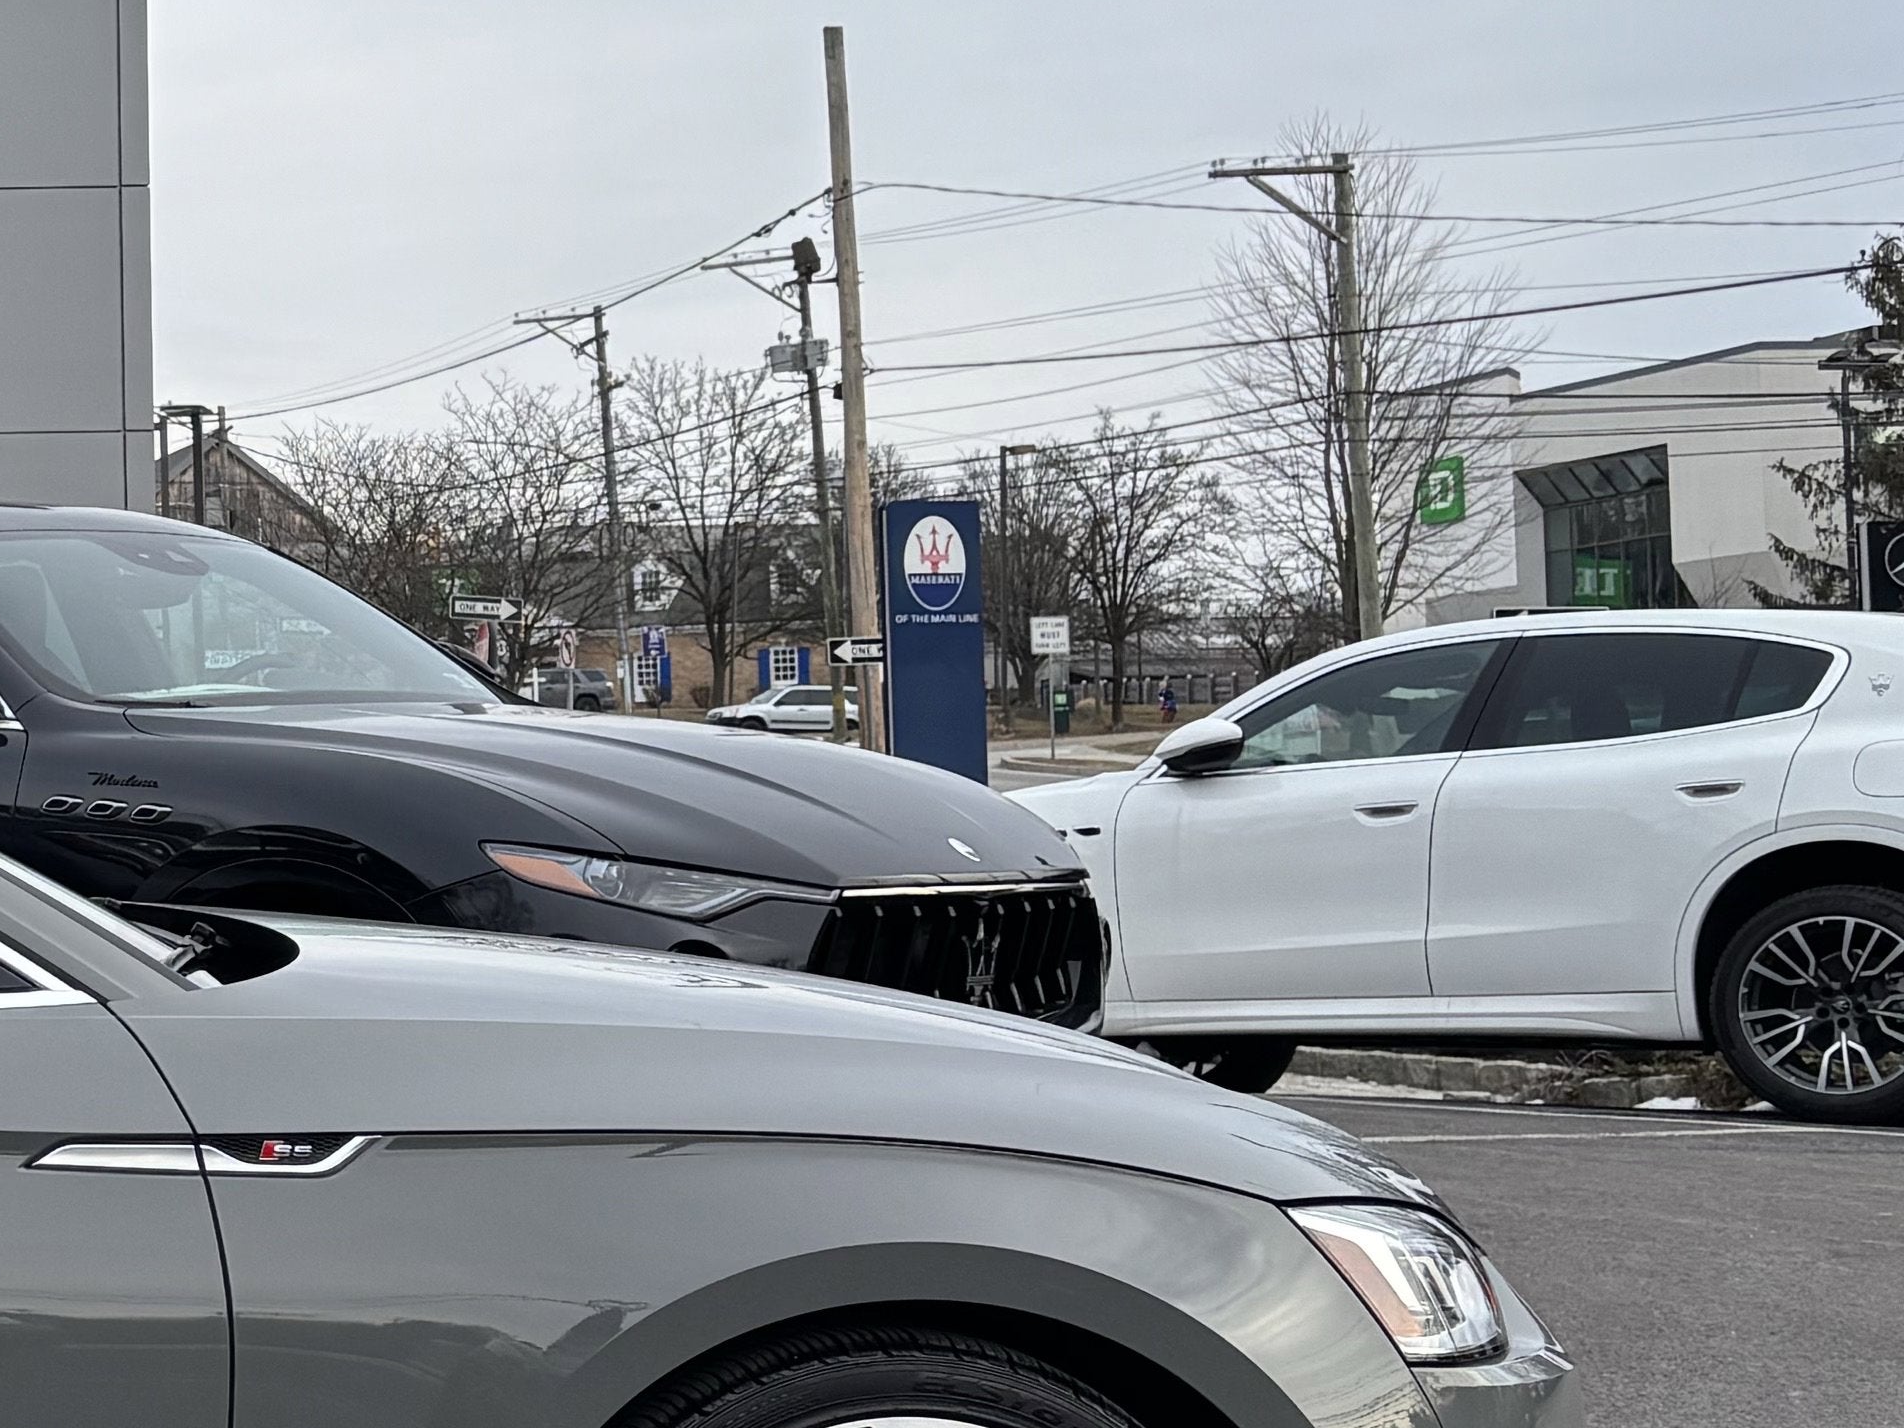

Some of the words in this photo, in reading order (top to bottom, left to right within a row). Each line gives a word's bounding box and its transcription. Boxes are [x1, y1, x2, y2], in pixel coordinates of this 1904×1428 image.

[911, 575, 960, 584] MASERATI
[460, 603, 476, 611] ONE
[483, 604, 500, 612] WAY
[895, 614, 909, 624] OF
[912, 614, 929, 623] THE
[931, 614, 956, 623] MAIN
[958, 614, 979, 623] LINE
[852, 646, 871, 655] ONE
[273, 1144, 312, 1157] S5
